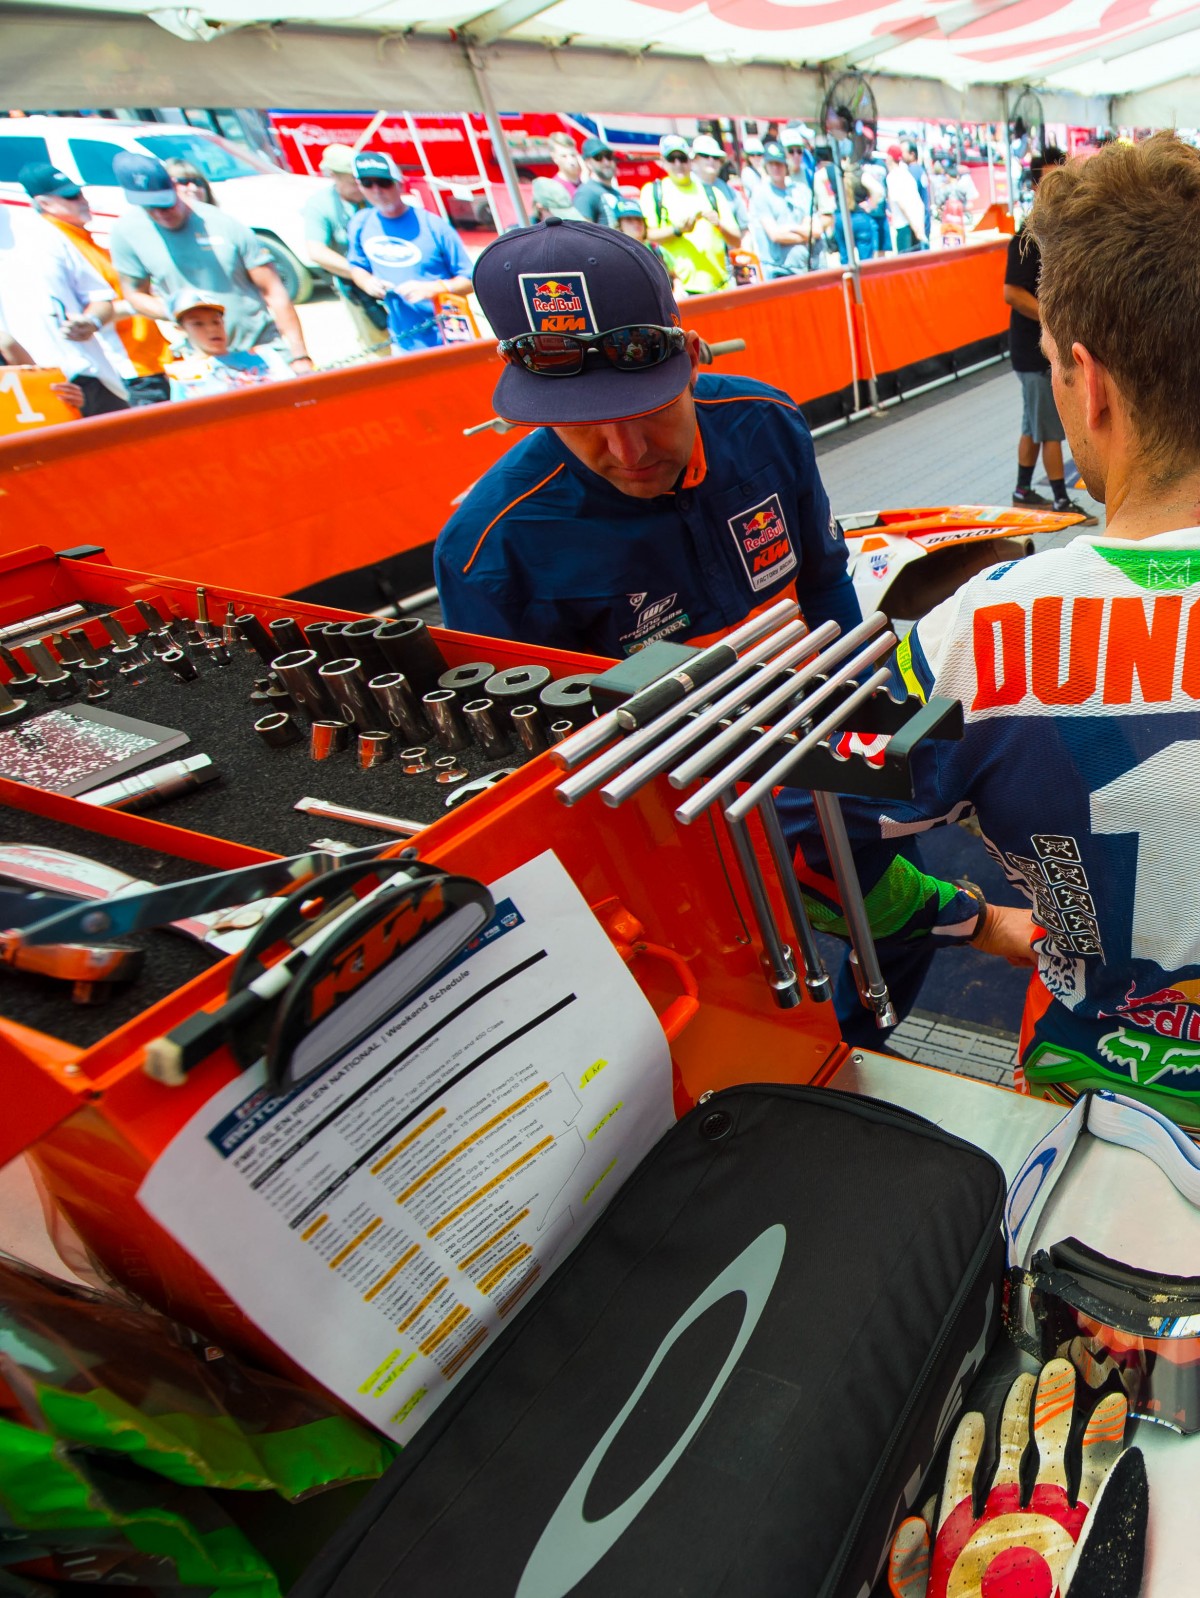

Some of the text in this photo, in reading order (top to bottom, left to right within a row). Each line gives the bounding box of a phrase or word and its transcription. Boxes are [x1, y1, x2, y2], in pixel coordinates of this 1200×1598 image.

[533, 296, 582, 312] Red Bull
[541, 315, 586, 331] KTM
[0, 372, 46, 423] 1
[743, 518, 784, 553] Red Bull
[926, 528, 1003, 544] DUNLOP
[753, 539, 789, 572] KTM
[756, 569, 779, 586] FACTORY
[644, 617, 687, 648] MOTOREX
[311, 882, 445, 1021] KTM
[385, 1001, 429, 1038] Weekend
[427, 968, 471, 1004] Schedule
